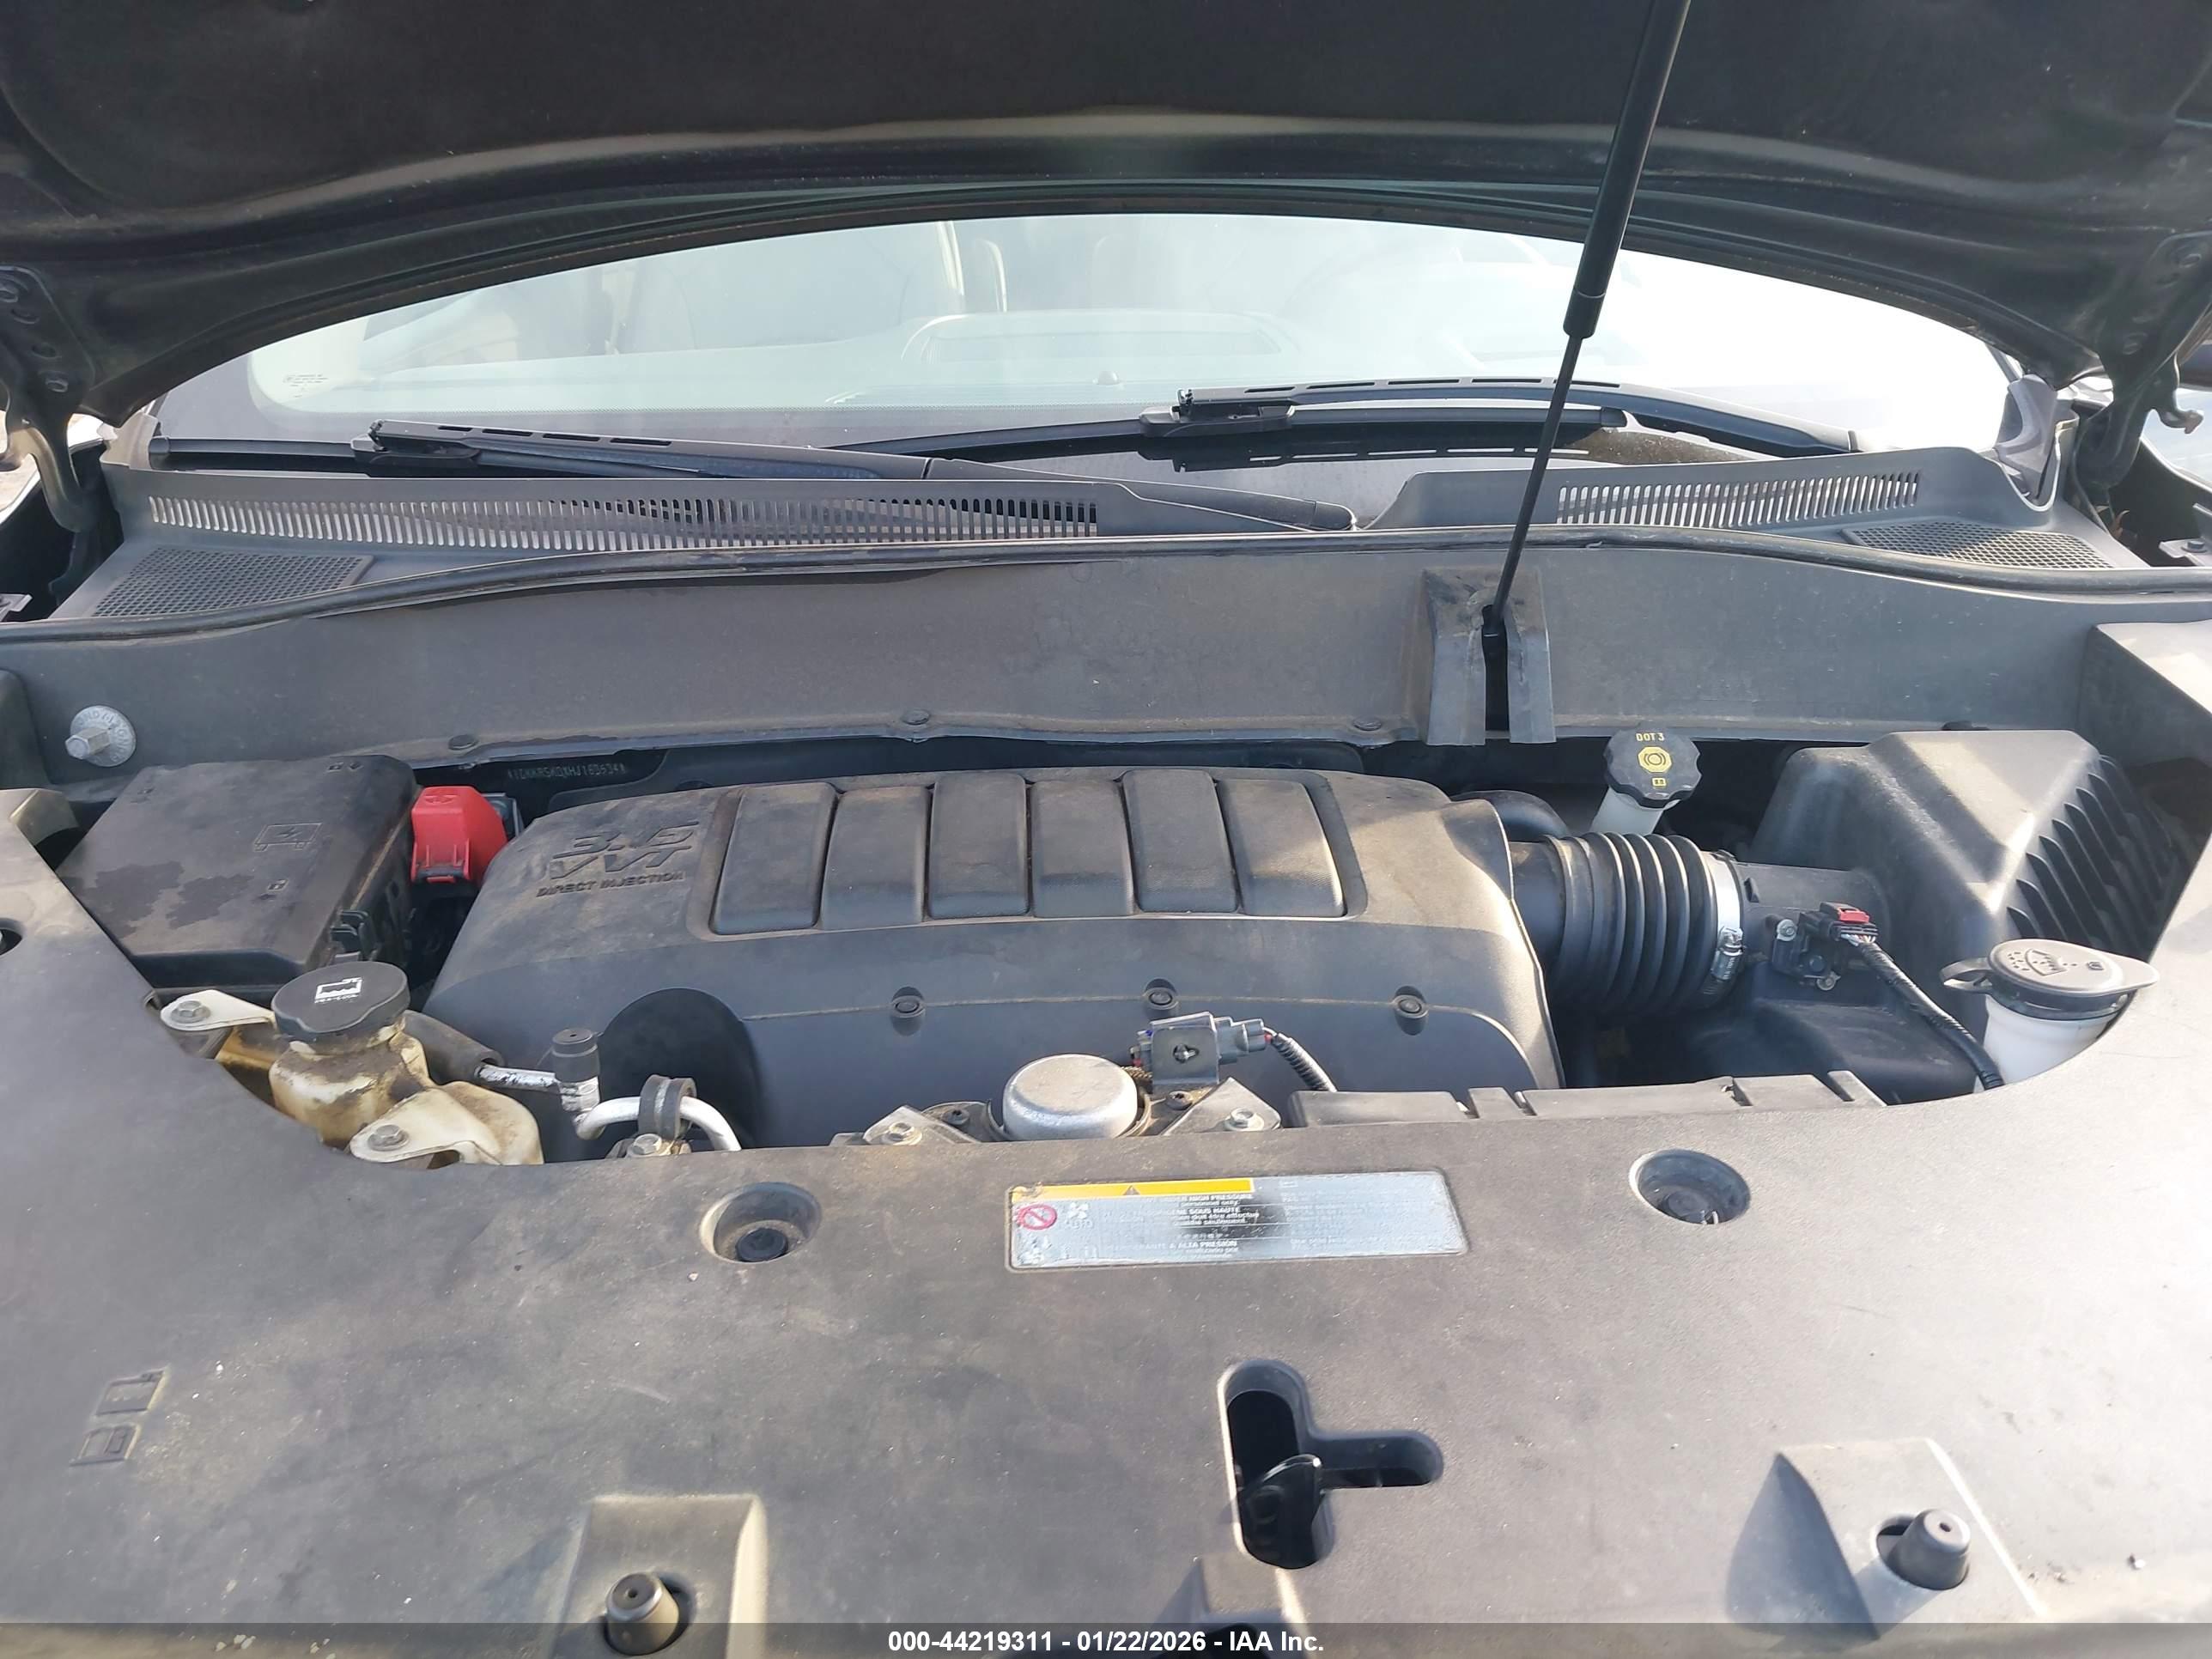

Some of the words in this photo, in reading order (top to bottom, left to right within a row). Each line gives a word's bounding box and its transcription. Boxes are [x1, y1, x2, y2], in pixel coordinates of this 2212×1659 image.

[1636, 732, 1656, 742] DOT
[1658, 732, 1665, 741] 3
[548, 845, 692, 880] VVT
[536, 881, 598, 897] DIRECT
[599, 873, 684, 889] INJECTION
